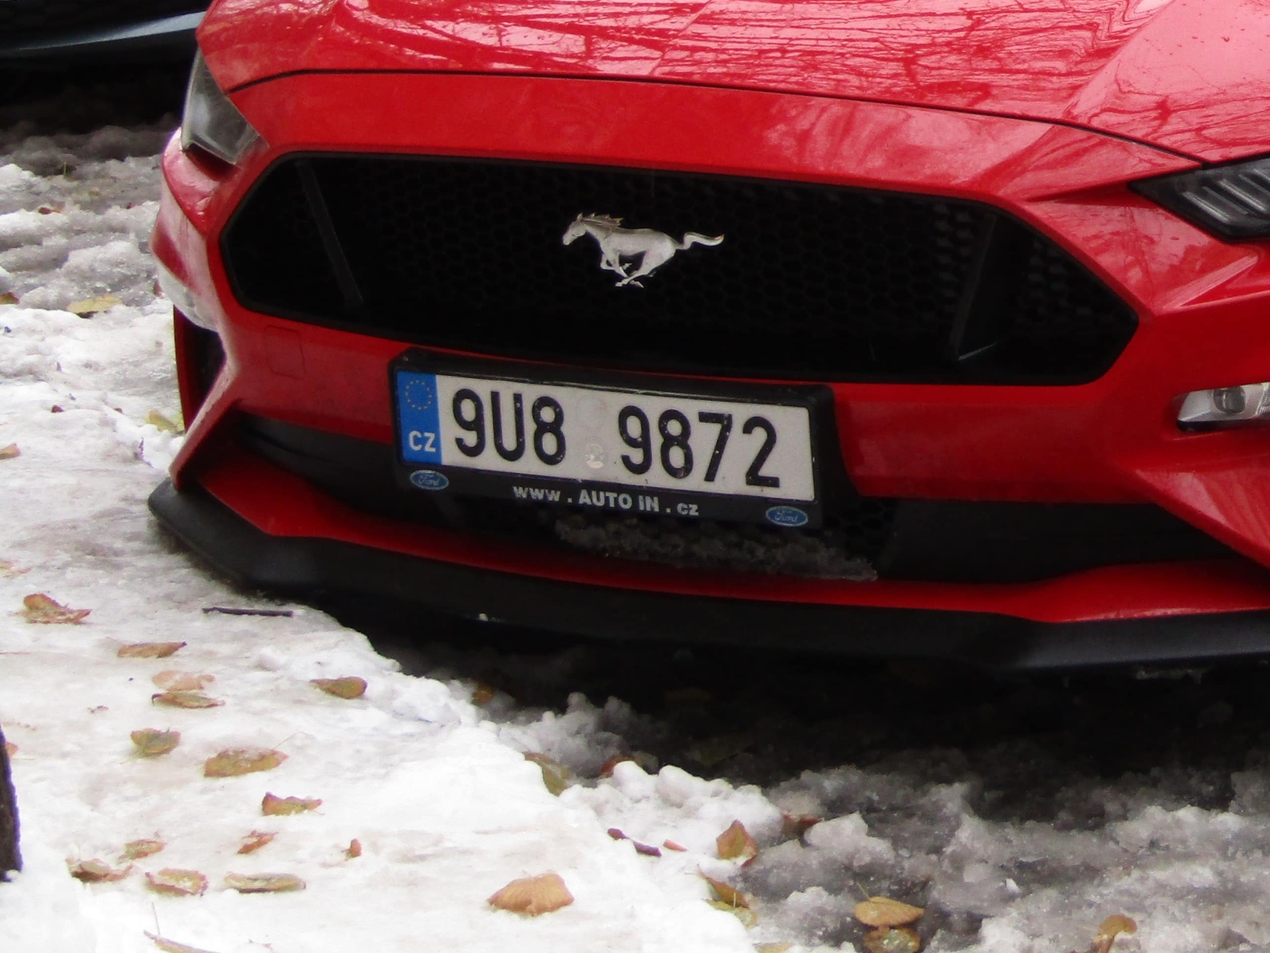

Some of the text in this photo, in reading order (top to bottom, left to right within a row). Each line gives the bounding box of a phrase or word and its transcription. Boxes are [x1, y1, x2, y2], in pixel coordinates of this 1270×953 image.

[408, 430, 437, 453] CZ
[452, 387, 780, 488] 9U8 9872
[578, 489, 632, 510] AUTO
